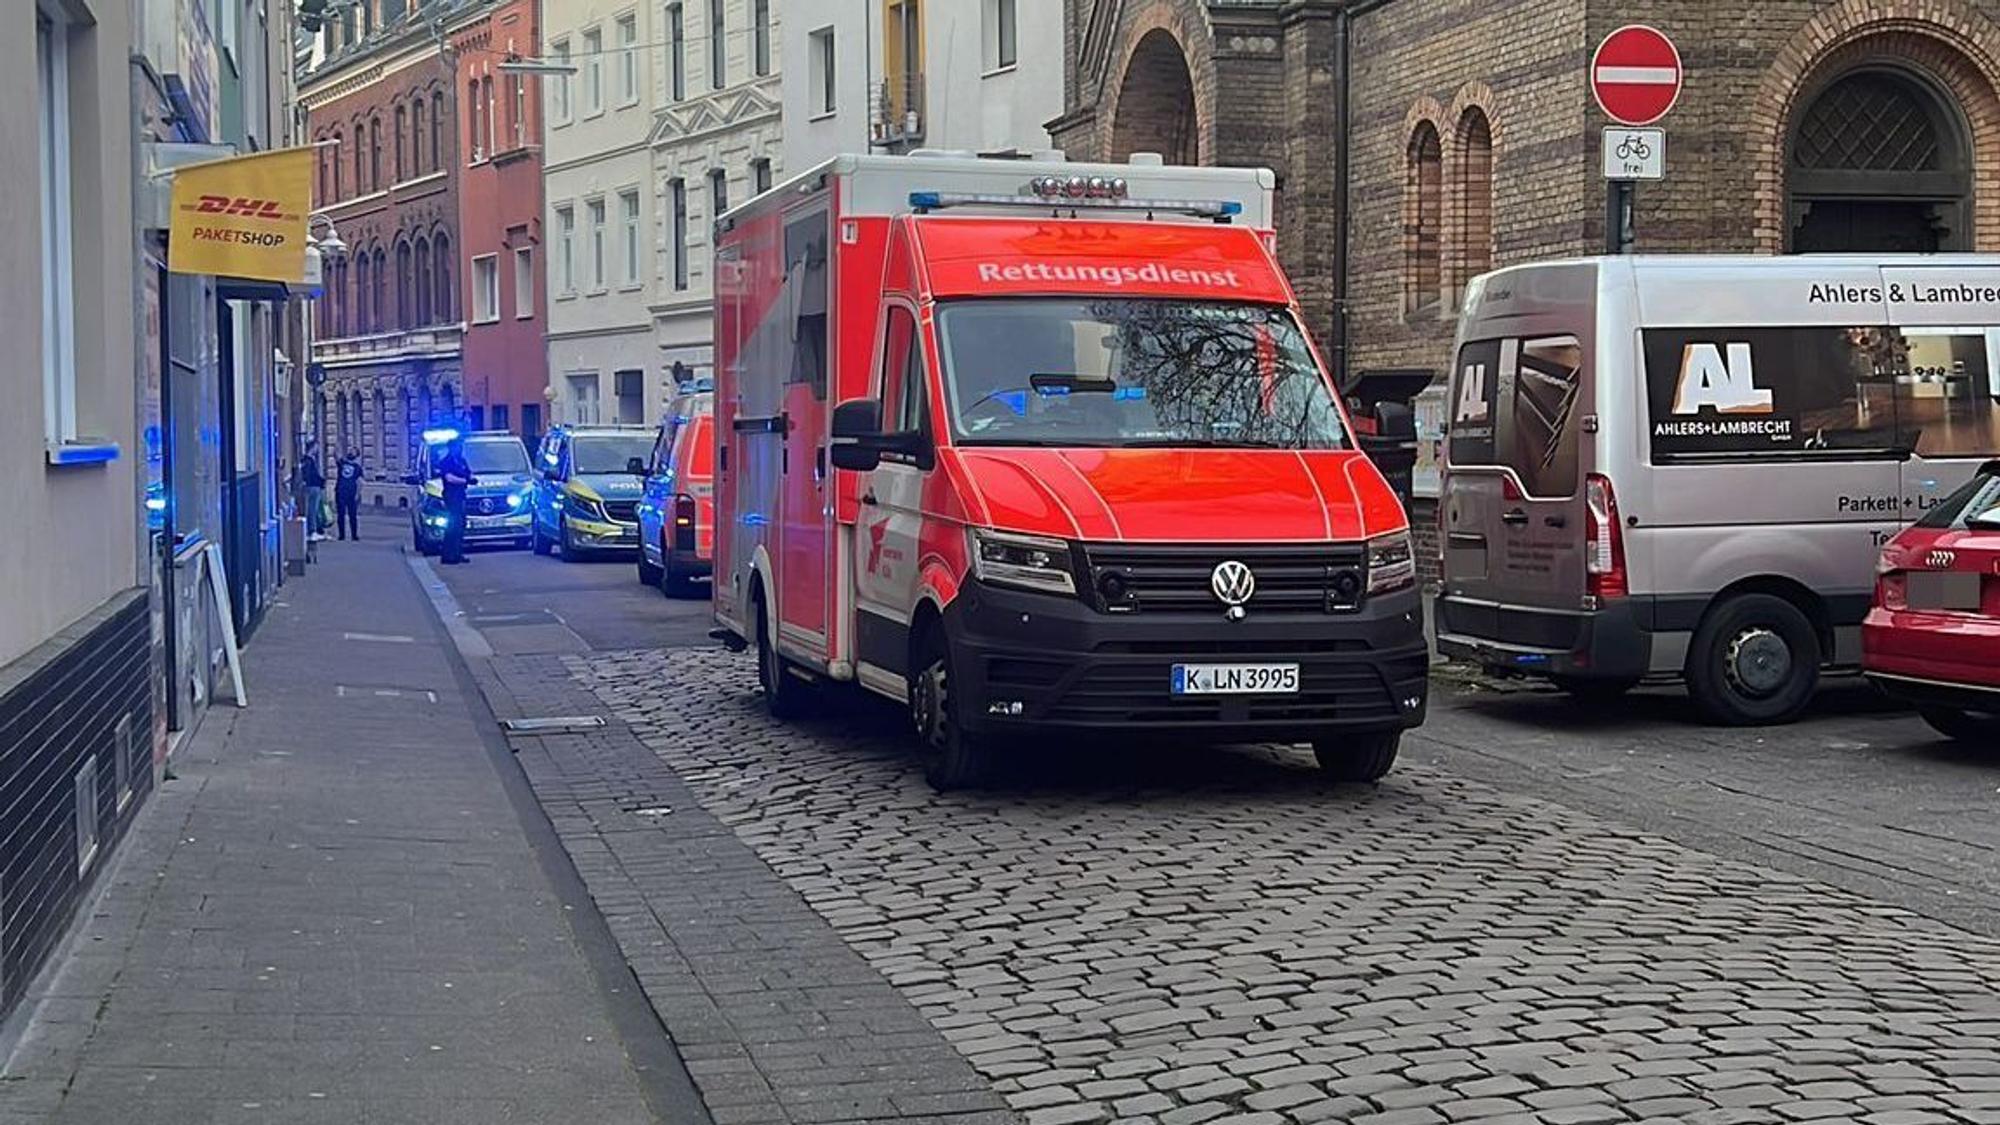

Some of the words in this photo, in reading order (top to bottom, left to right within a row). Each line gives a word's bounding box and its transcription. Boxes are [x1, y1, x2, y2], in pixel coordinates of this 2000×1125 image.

[1623, 162, 1644, 174] frei
[197, 195, 284, 220] DHL
[192, 227, 285, 247] PAKETSHOP
[978, 262, 1241, 288] Rettungsdienst
[1808, 284, 1882, 303] Ahlers
[1889, 283, 1906, 303] &
[1672, 343, 1774, 415] AL
[1456, 364, 1488, 422] AL
[1654, 420, 1792, 436] AHLERS+LAMBRECHT
[1838, 496, 1898, 512] Parkett
[1903, 497, 1913, 508] +
[1870, 530, 1896, 546] Te
[1187, 669, 1199, 689] K
[1214, 668, 1241, 689] LN
[1245, 668, 1296, 689] 3995
